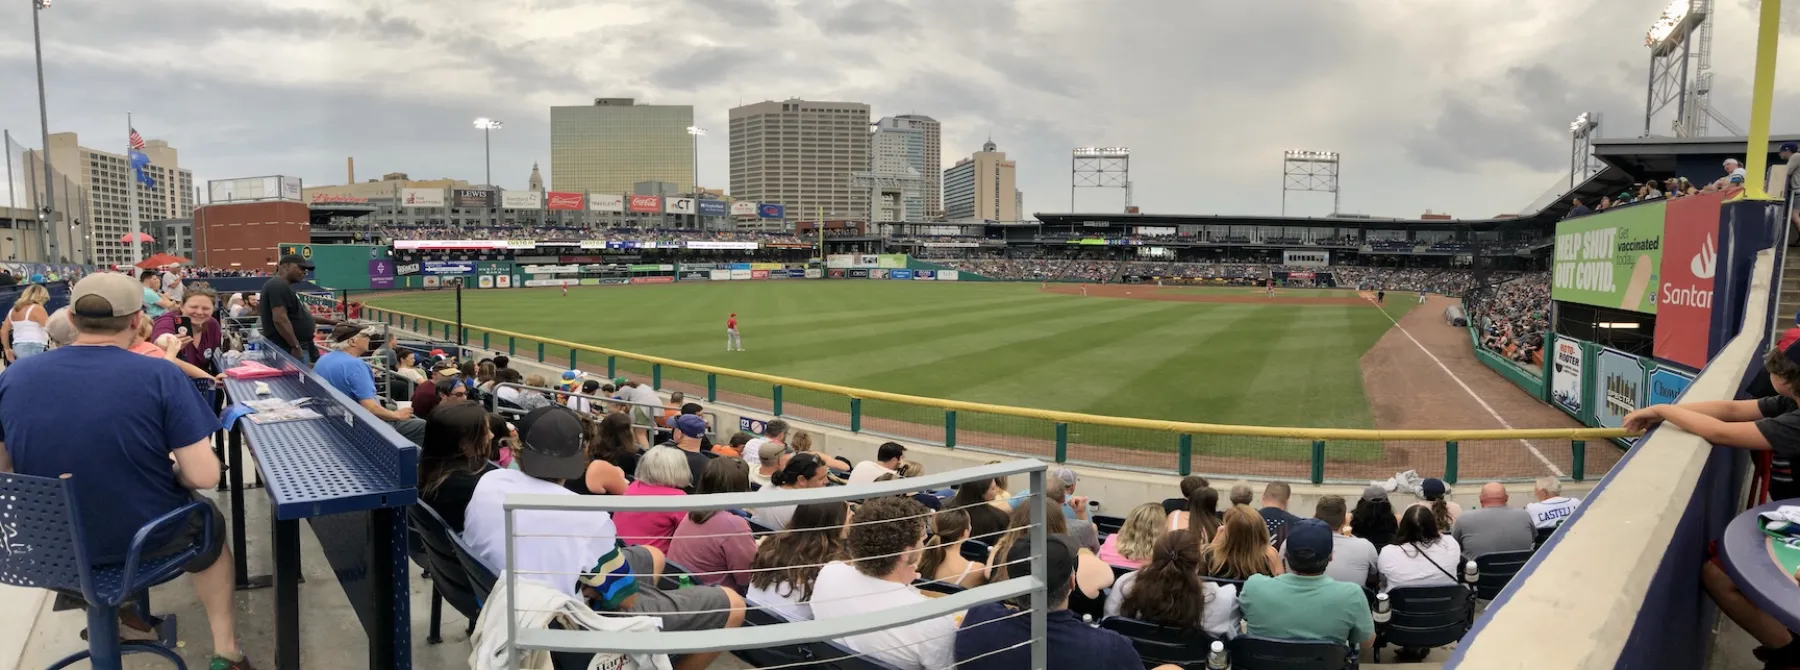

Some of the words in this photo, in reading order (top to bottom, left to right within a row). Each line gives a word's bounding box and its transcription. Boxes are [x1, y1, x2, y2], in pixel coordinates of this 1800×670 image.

[461, 190, 487, 198] LEWIS
[632, 197, 657, 207] Coca-Cola
[677, 199, 691, 210] CT
[1618, 227, 1629, 239] Get
[1557, 232, 1582, 261] HELP
[1582, 227, 1617, 260] SHUT
[1617, 235, 1659, 252] vaccinated
[1555, 262, 1576, 289] OUT
[1575, 261, 1616, 293] COVID.
[1560, 343, 1576, 355] ROTO-
[1558, 351, 1580, 367] ROOTER
[1607, 389, 1635, 407] SPECTRA
